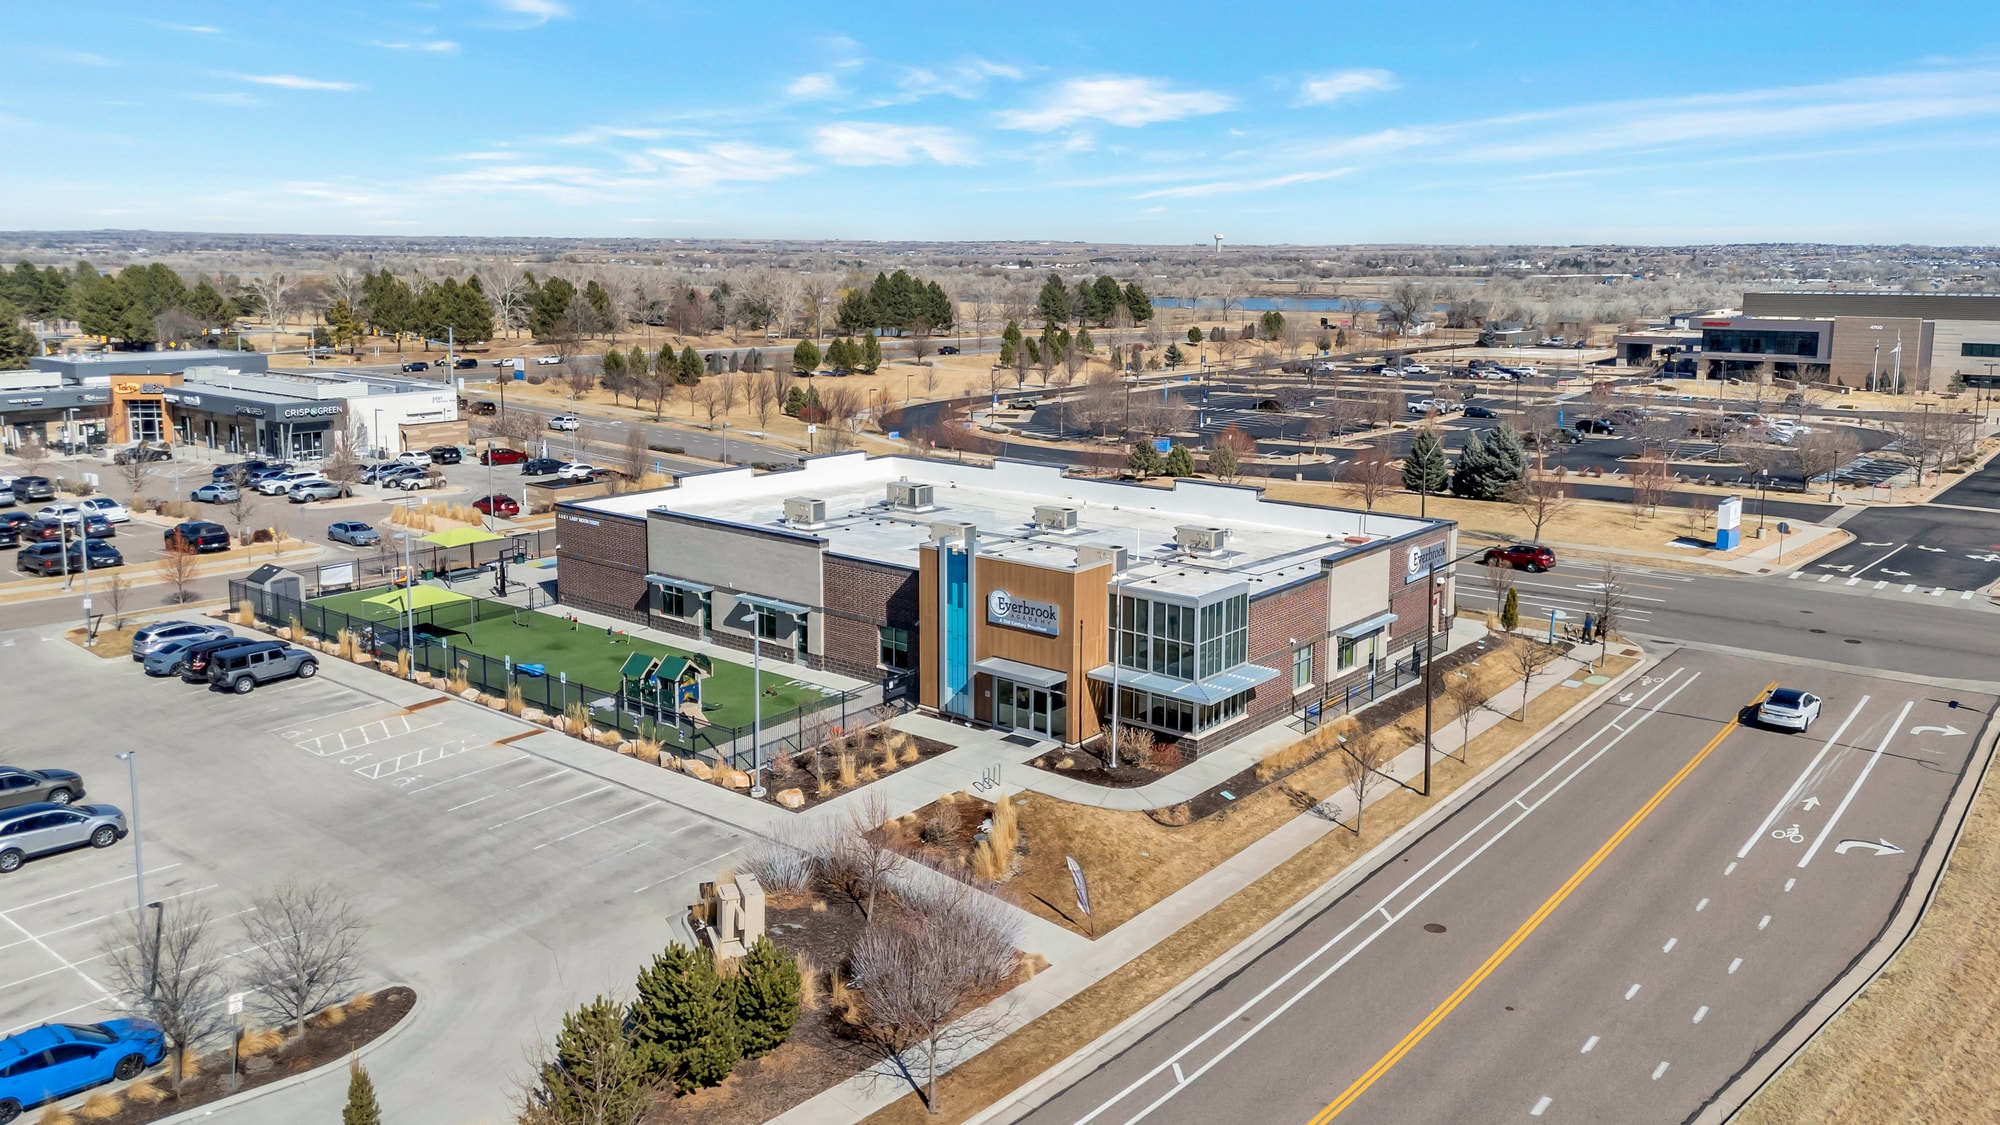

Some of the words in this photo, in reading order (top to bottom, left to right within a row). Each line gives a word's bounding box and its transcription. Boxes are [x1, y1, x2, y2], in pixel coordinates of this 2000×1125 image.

[284, 408, 309, 418] CRISP
[318, 406, 343, 415] GREEN
[998, 596, 1057, 621] Everbrook
[1010, 613, 1052, 626] ACADEMY
